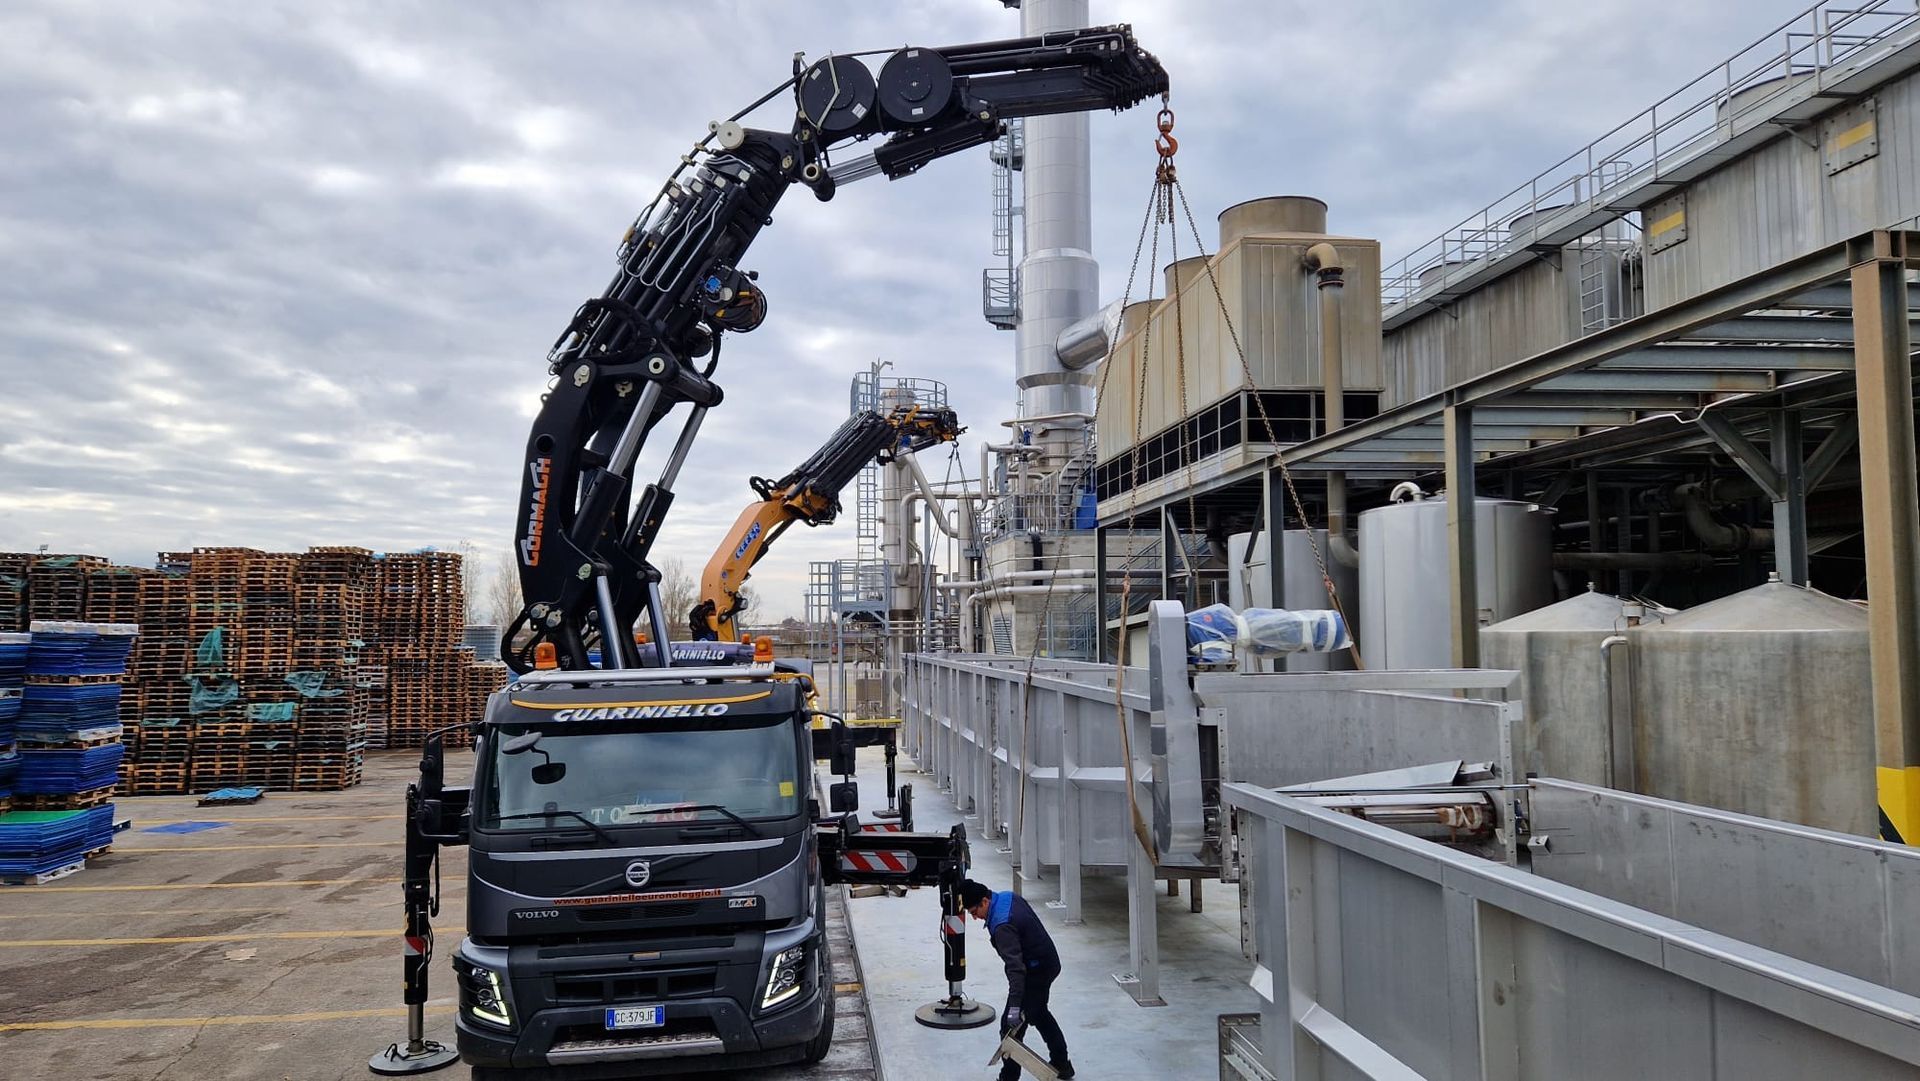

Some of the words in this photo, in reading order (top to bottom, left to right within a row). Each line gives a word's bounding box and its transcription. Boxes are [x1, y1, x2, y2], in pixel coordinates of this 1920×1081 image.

[520, 457, 551, 567] CORMACH
[552, 703, 729, 722] GUARINIELLO
[553, 889, 722, 906] www.guarinielloeuronoleggio.it
[515, 910, 559, 919] VOLVO
